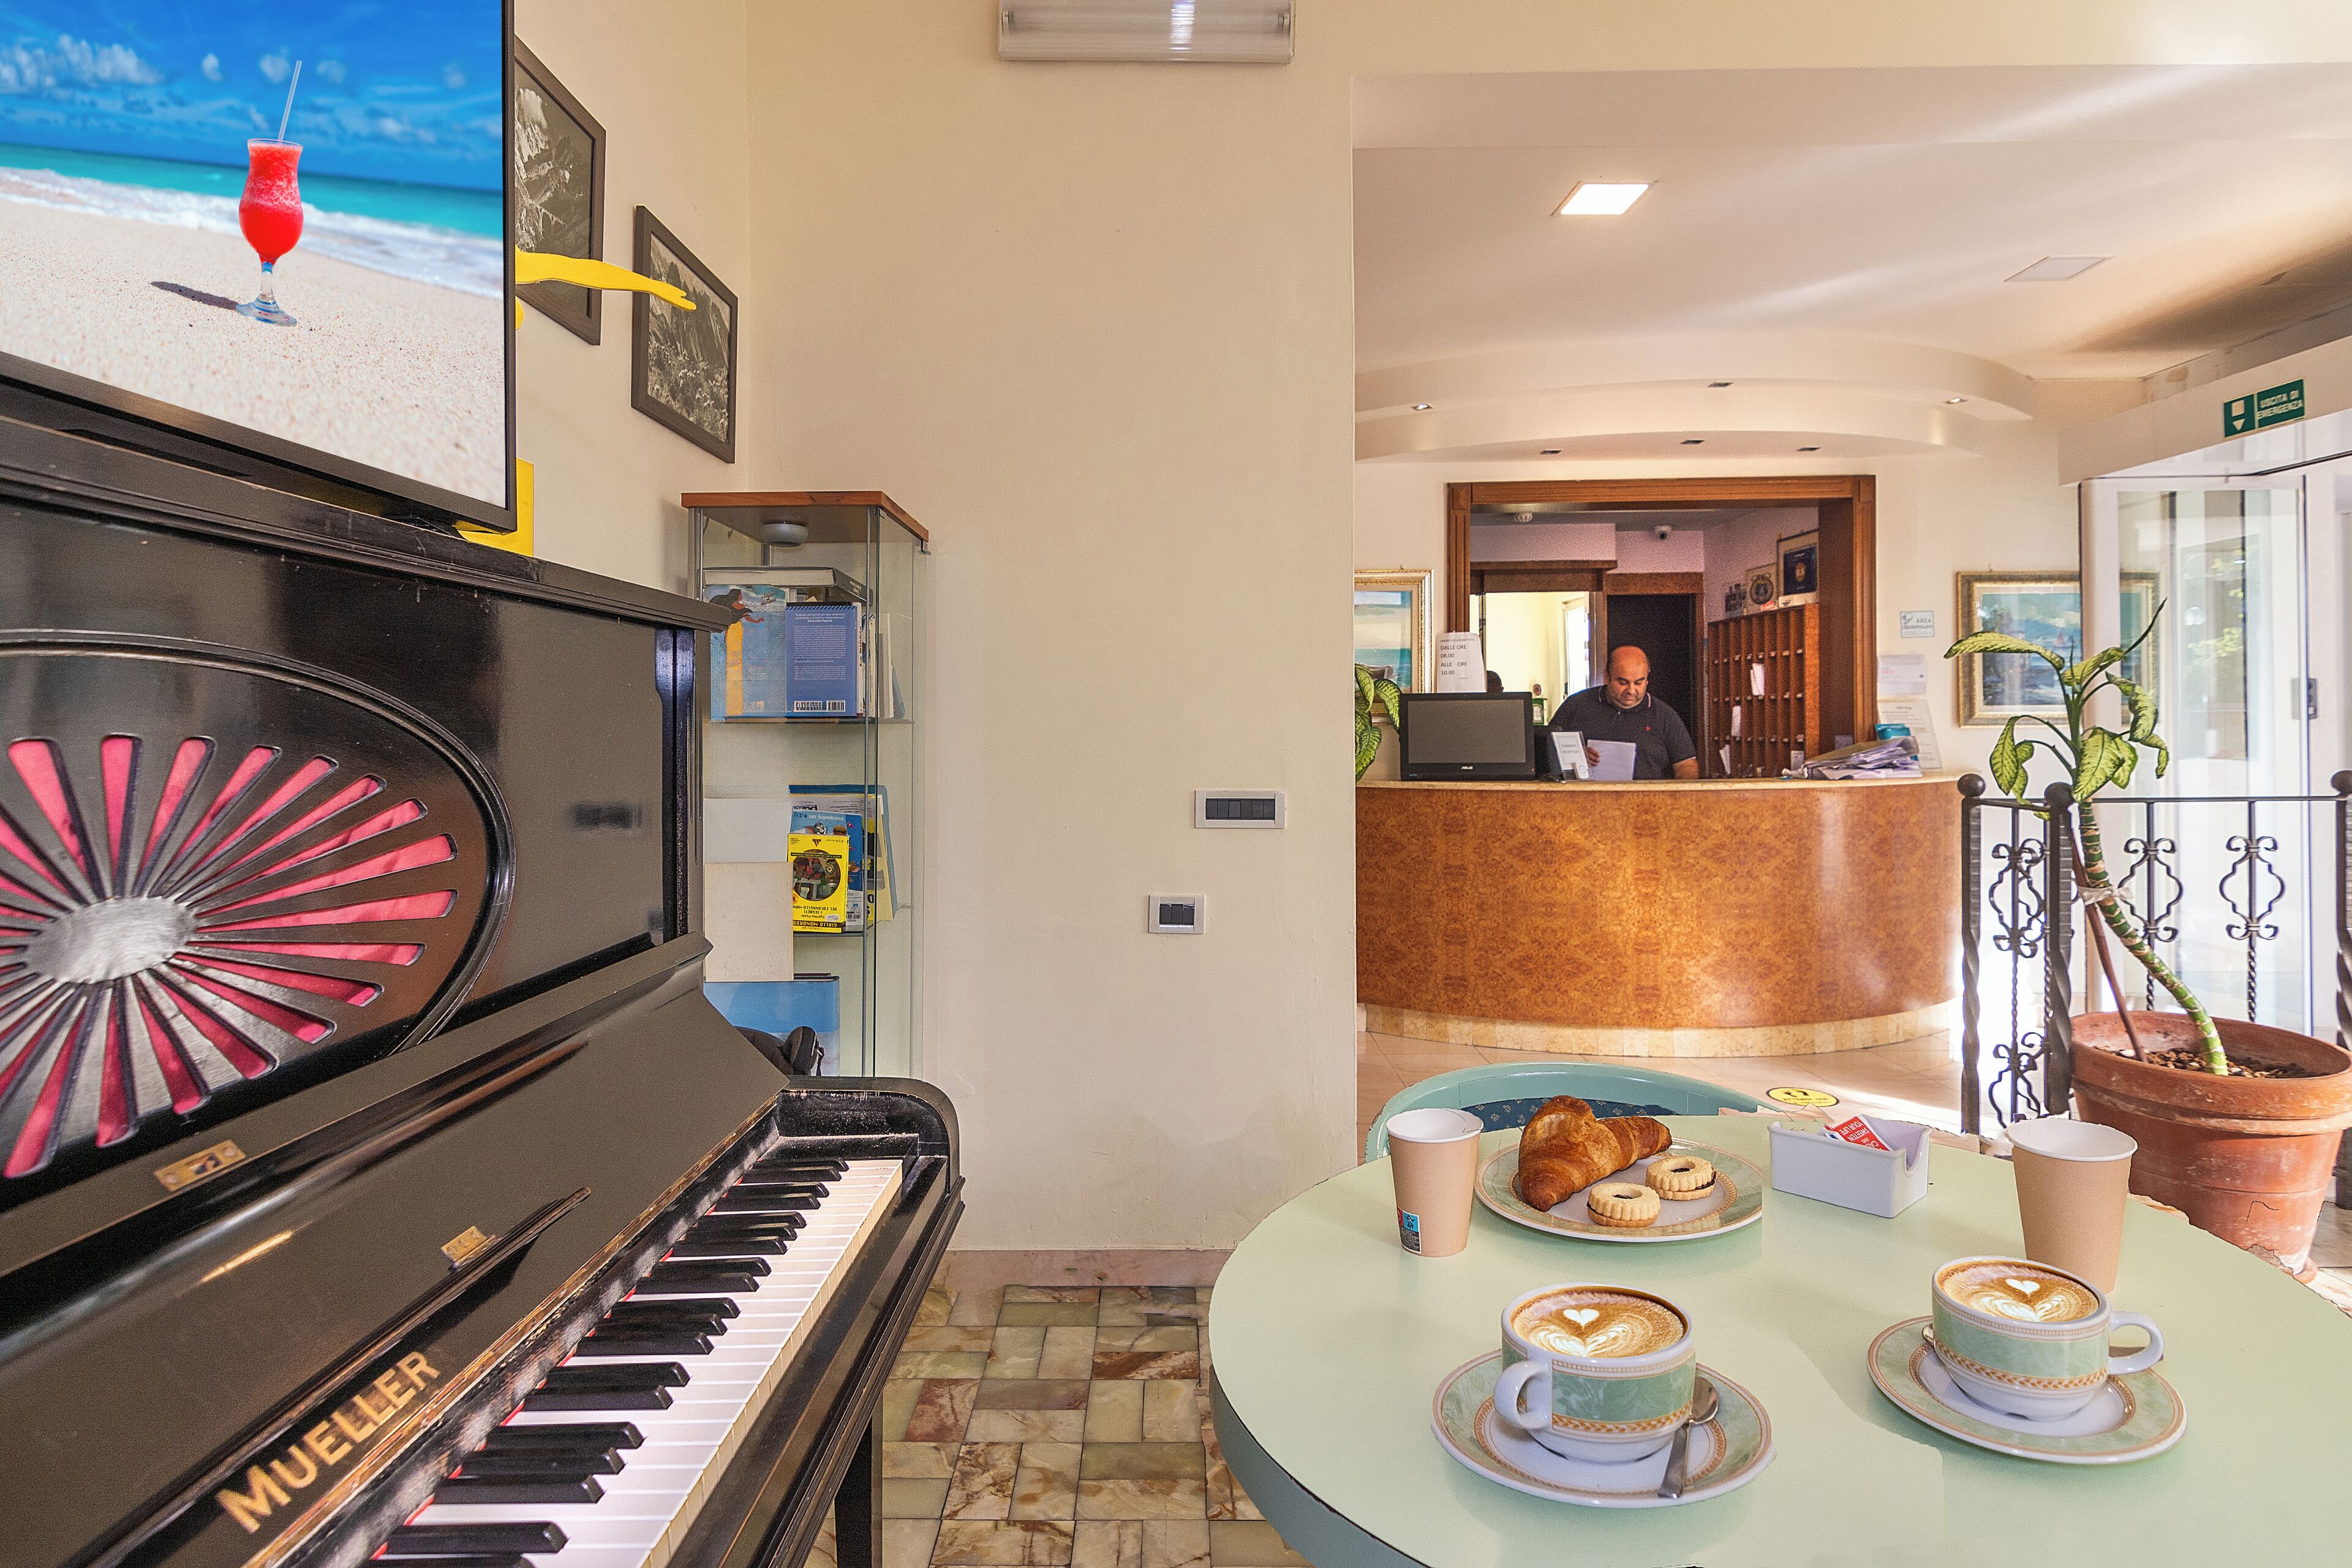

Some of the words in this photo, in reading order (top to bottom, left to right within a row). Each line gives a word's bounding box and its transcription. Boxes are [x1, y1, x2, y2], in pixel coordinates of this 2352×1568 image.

[1839, 1127, 1851, 1136] LIFE
[1849, 1120, 1864, 1131] YOUR
[1847, 1127, 1870, 1142] SWEETEN
[215, 1350, 442, 1534] MUELLER
